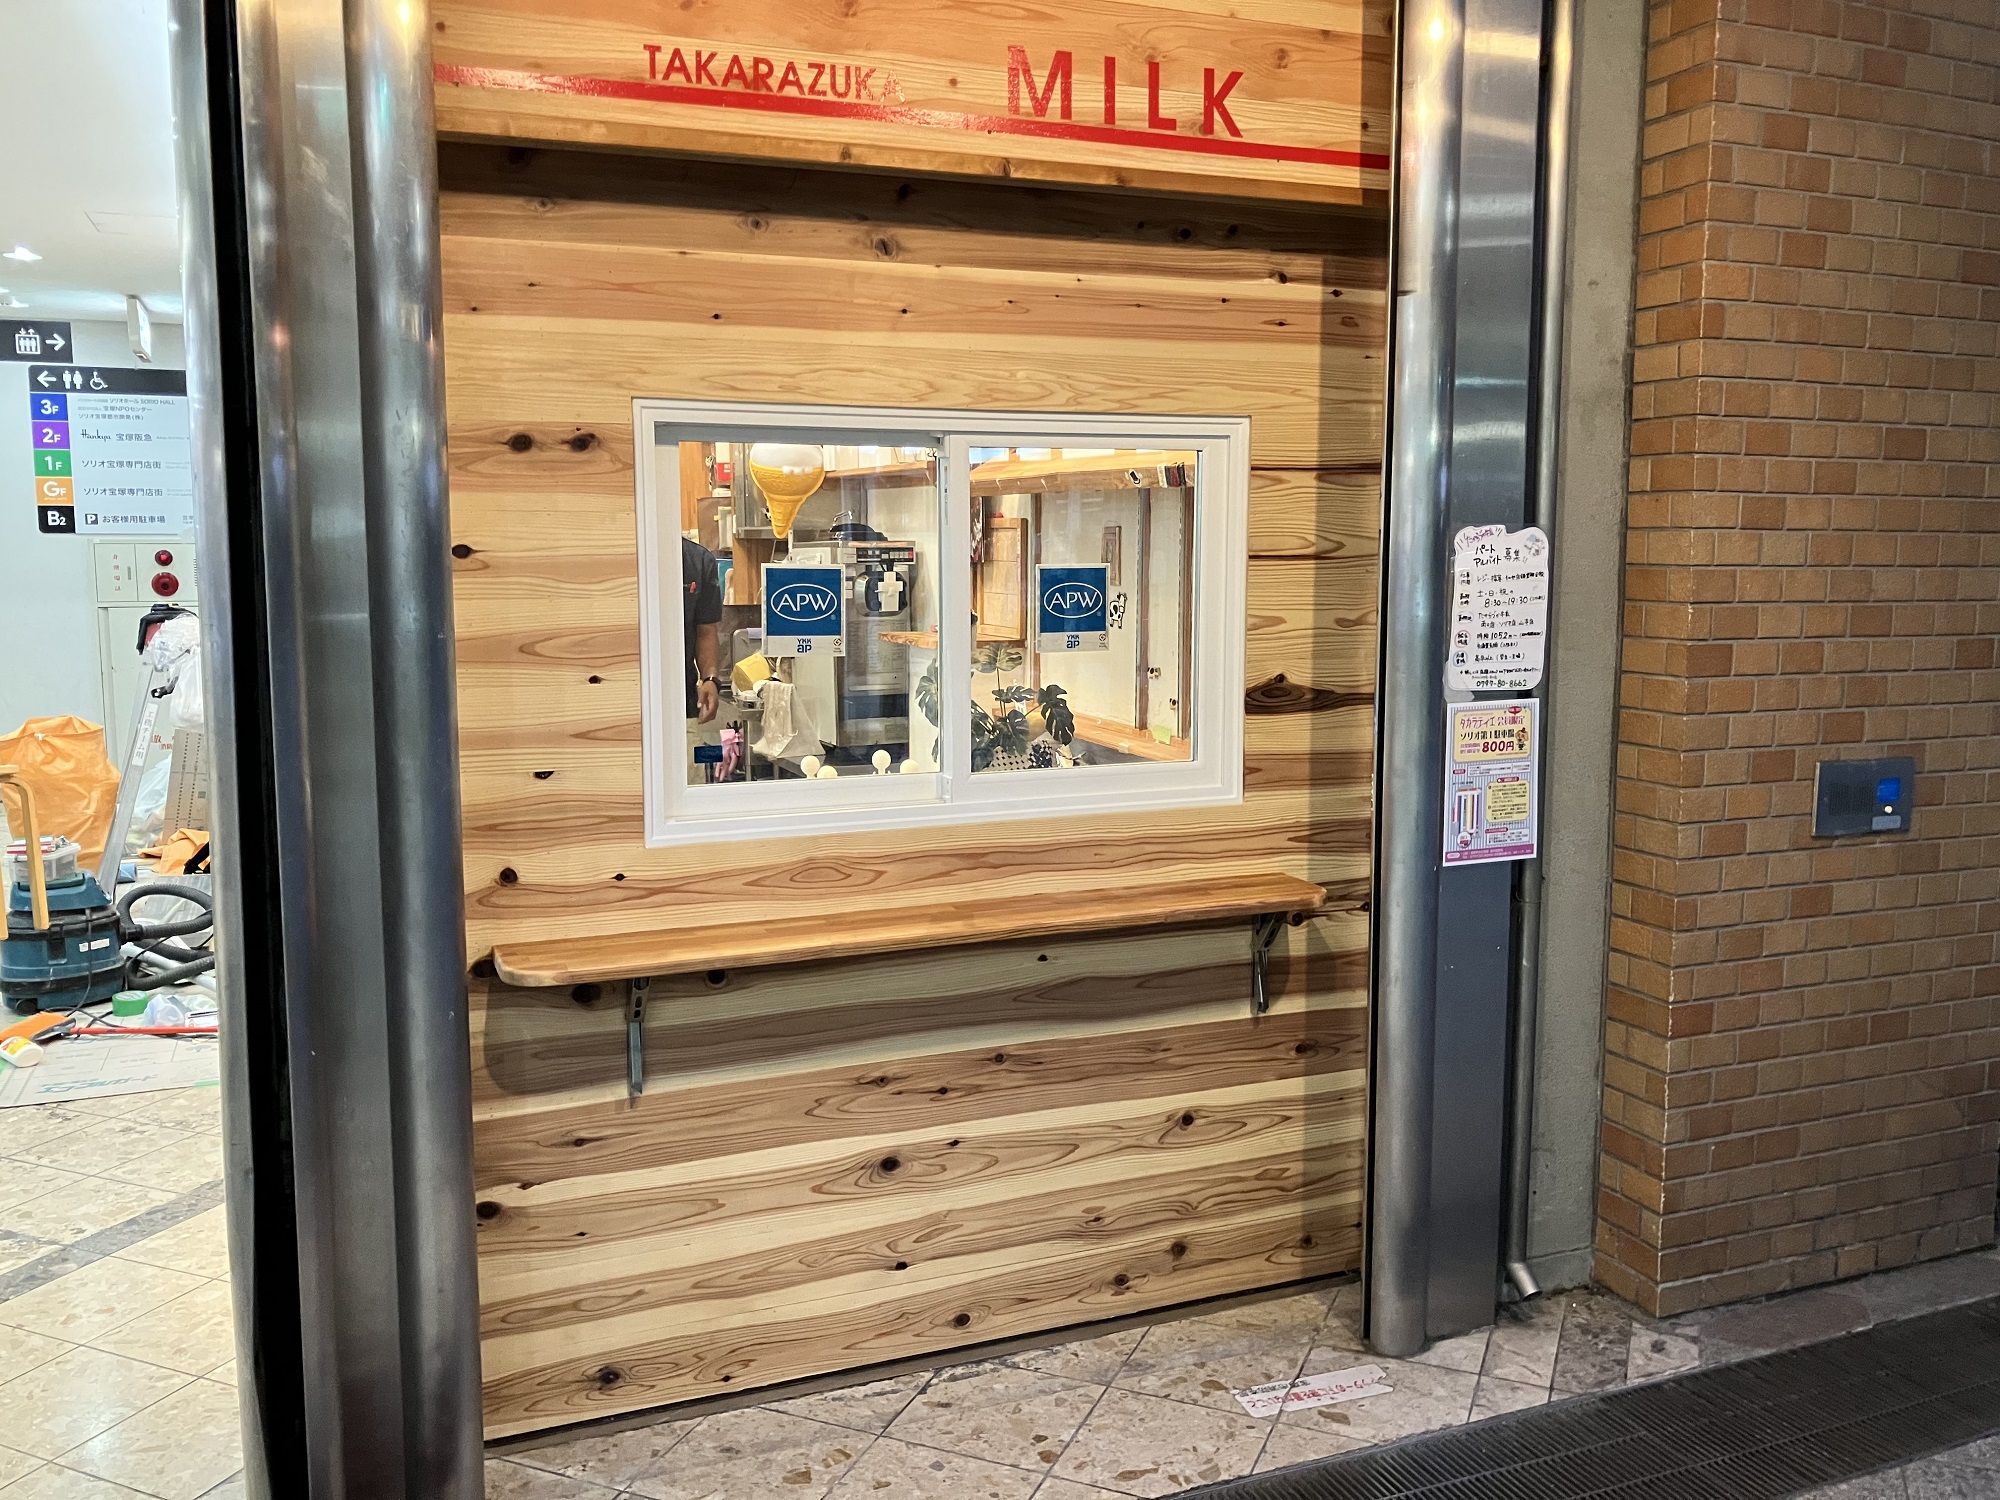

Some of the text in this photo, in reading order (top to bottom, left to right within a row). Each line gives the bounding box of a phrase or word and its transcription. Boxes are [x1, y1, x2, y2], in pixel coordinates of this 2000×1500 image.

[643, 44, 1244, 138] TAKARAZUKA MILK
[40, 399, 59, 415] 3F
[42, 428, 61, 443] 2F
[115, 433, 152, 442] 宝塚阪急
[44, 455, 63, 471] 1F
[82, 460, 161, 469] ソリオ宝塚専門店街
[43, 481, 66, 497] GF
[84, 488, 163, 496] ソリオ宝塚専門店街
[47, 510, 66, 526] B2
[102, 515, 165, 524] お客様用駐車場
[1475, 543, 1496, 555] パート
[1473, 555, 1502, 567] アルバイト
[777, 593, 832, 611] APW
[1049, 591, 1098, 610] APW
[1482, 741, 1514, 753] 800円
